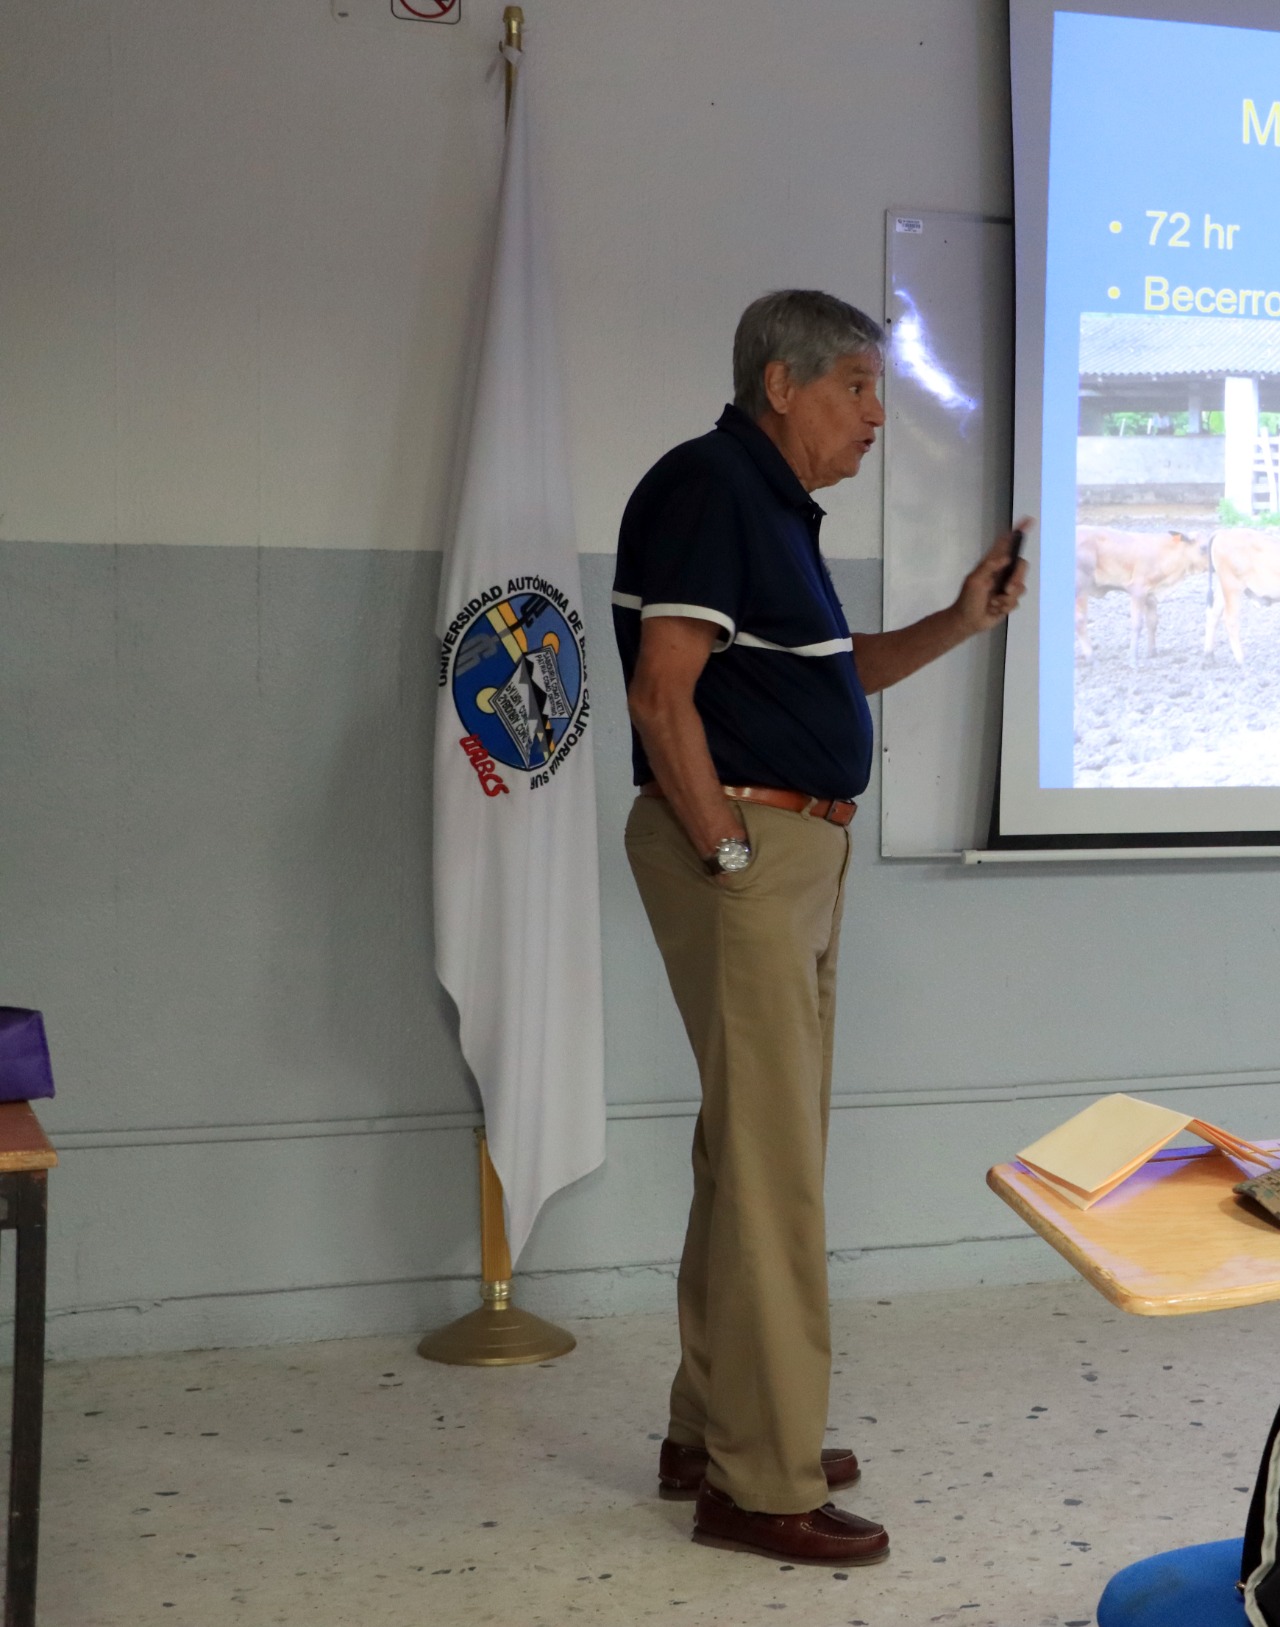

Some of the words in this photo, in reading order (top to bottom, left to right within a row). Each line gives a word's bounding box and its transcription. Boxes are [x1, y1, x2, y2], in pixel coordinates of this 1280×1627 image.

[1145, 210, 1191, 248] 72
[1201, 214, 1240, 250] hr
[506, 574, 570, 614] AUTÓNOMA
[438, 584, 503, 688] UNIVERSIDAD
[566, 609, 584, 635] DE
[547, 688, 591, 776] CALIFORNIA
